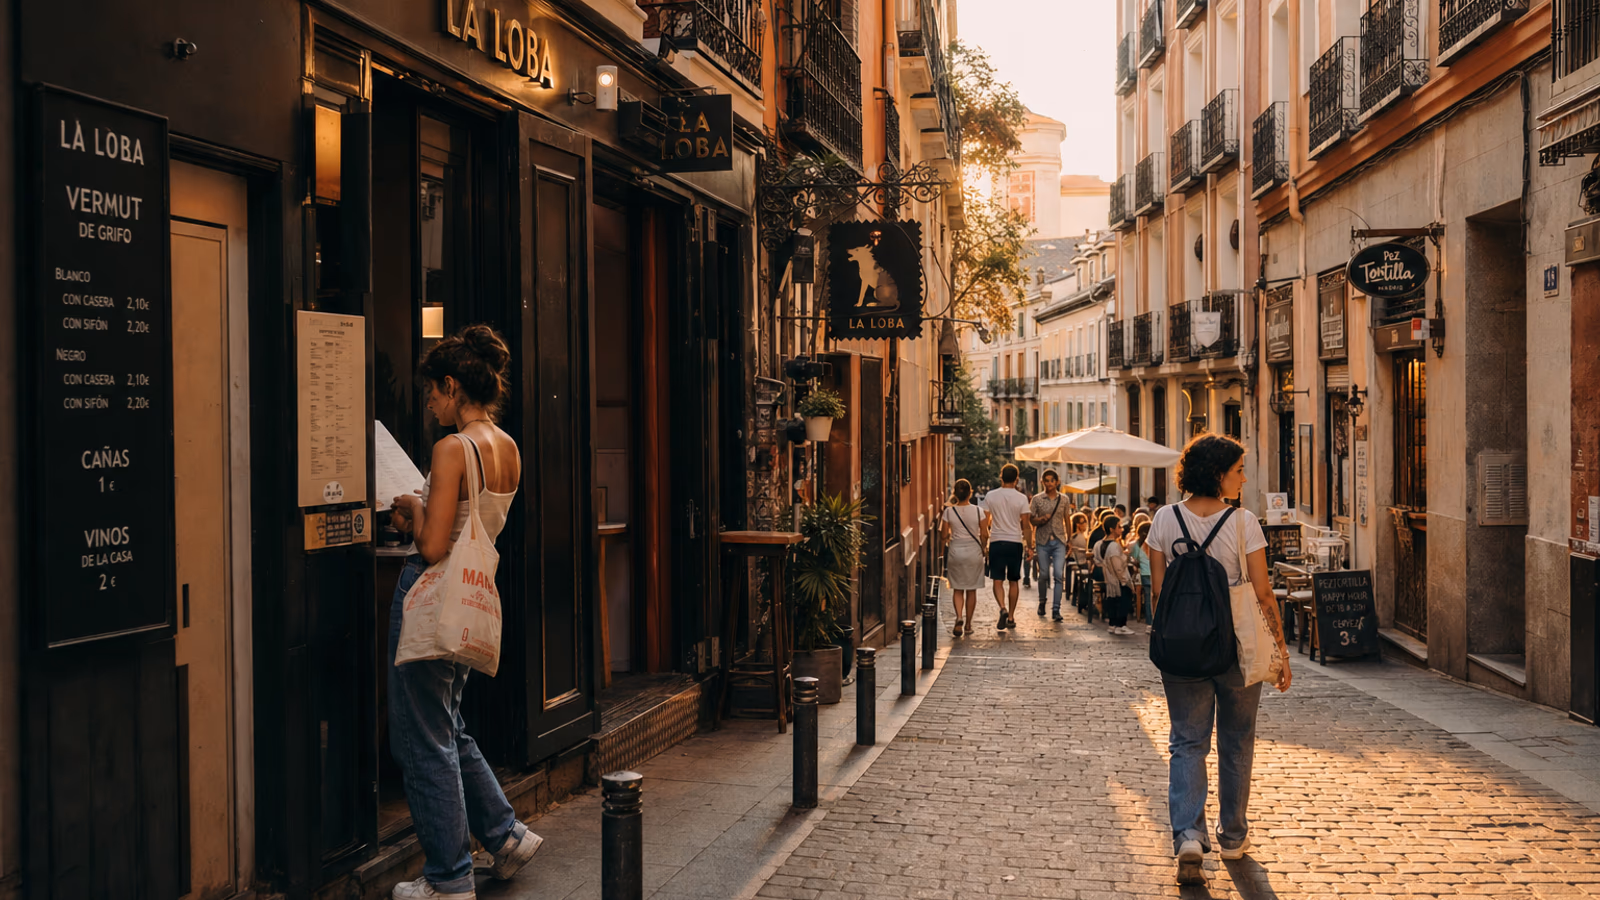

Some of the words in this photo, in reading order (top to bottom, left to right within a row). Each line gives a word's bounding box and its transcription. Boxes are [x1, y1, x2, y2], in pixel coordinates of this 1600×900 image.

[446, 0, 483, 51] LA
[494, 8, 554, 89] LOBA
[680, 111, 711, 133] LA
[661, 136, 729, 160] LOBA
[65, 185, 143, 221] VERMUT
[79, 222, 95, 239] DE
[98, 224, 132, 244] GRIFO
[55, 267, 91, 283] BLANCO
[1358, 261, 1416, 283] Tortilla
[62, 293, 82, 305] CON
[83, 294, 115, 308] CASERA
[127, 296, 150, 311] 2,10€
[63, 317, 82, 329] CON
[83, 316, 108, 331] SIFÓN
[127, 320, 150, 334] 2,20€
[849, 318, 865, 329] LA
[870, 317, 905, 329] LOBA
[56, 348, 87, 361] NEGRO
[63, 373, 82, 385] CON
[83, 374, 115, 385] CASERA
[127, 373, 150, 387] 2,10€
[63, 397, 82, 409] CON
[84, 395, 109, 409] SIFÓN
[127, 396, 150, 410] 2,20€
[81, 445, 130, 469] CAÑAS
[98, 476, 104, 493] 1
[84, 526, 130, 548] VINOS
[81, 554, 94, 568] DE
[97, 553, 108, 566] LA
[110, 550, 133, 564] CASA
[1321, 592, 1346, 602] HAPPY
[1347, 591, 1368, 600] HOUR
